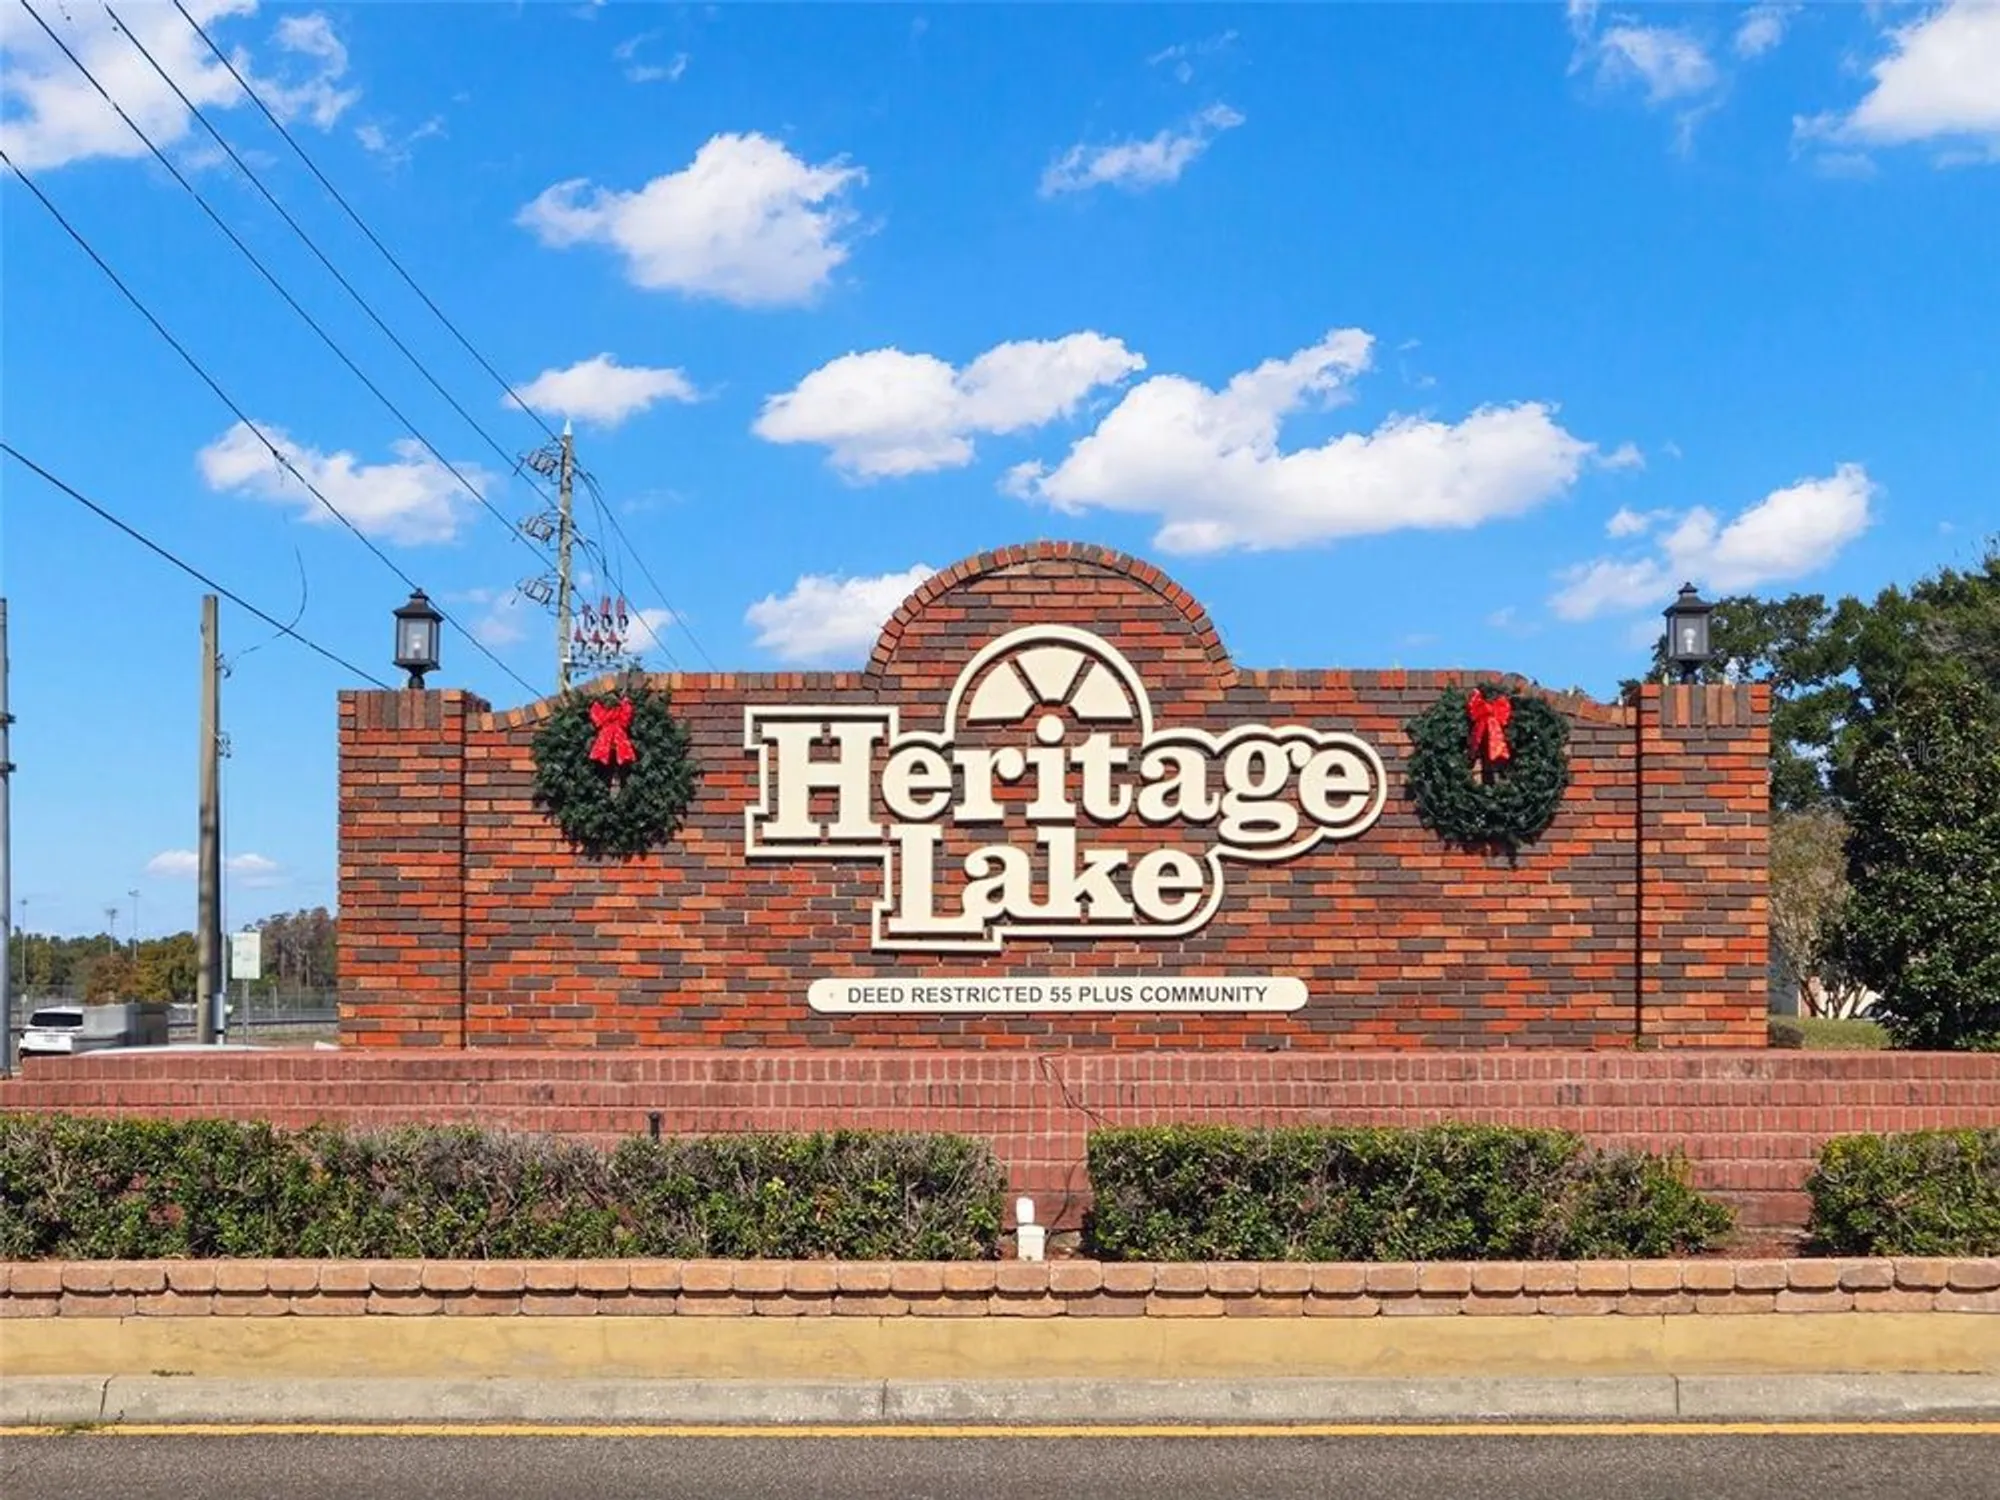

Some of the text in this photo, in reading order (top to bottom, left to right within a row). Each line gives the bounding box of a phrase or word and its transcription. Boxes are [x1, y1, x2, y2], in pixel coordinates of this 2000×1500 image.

[762, 713, 1370, 842] Heritage
[888, 824, 1204, 933] Lake
[848, 986, 1268, 1004] DEED RESTRICTED 55 PLUS COMMUNITY
